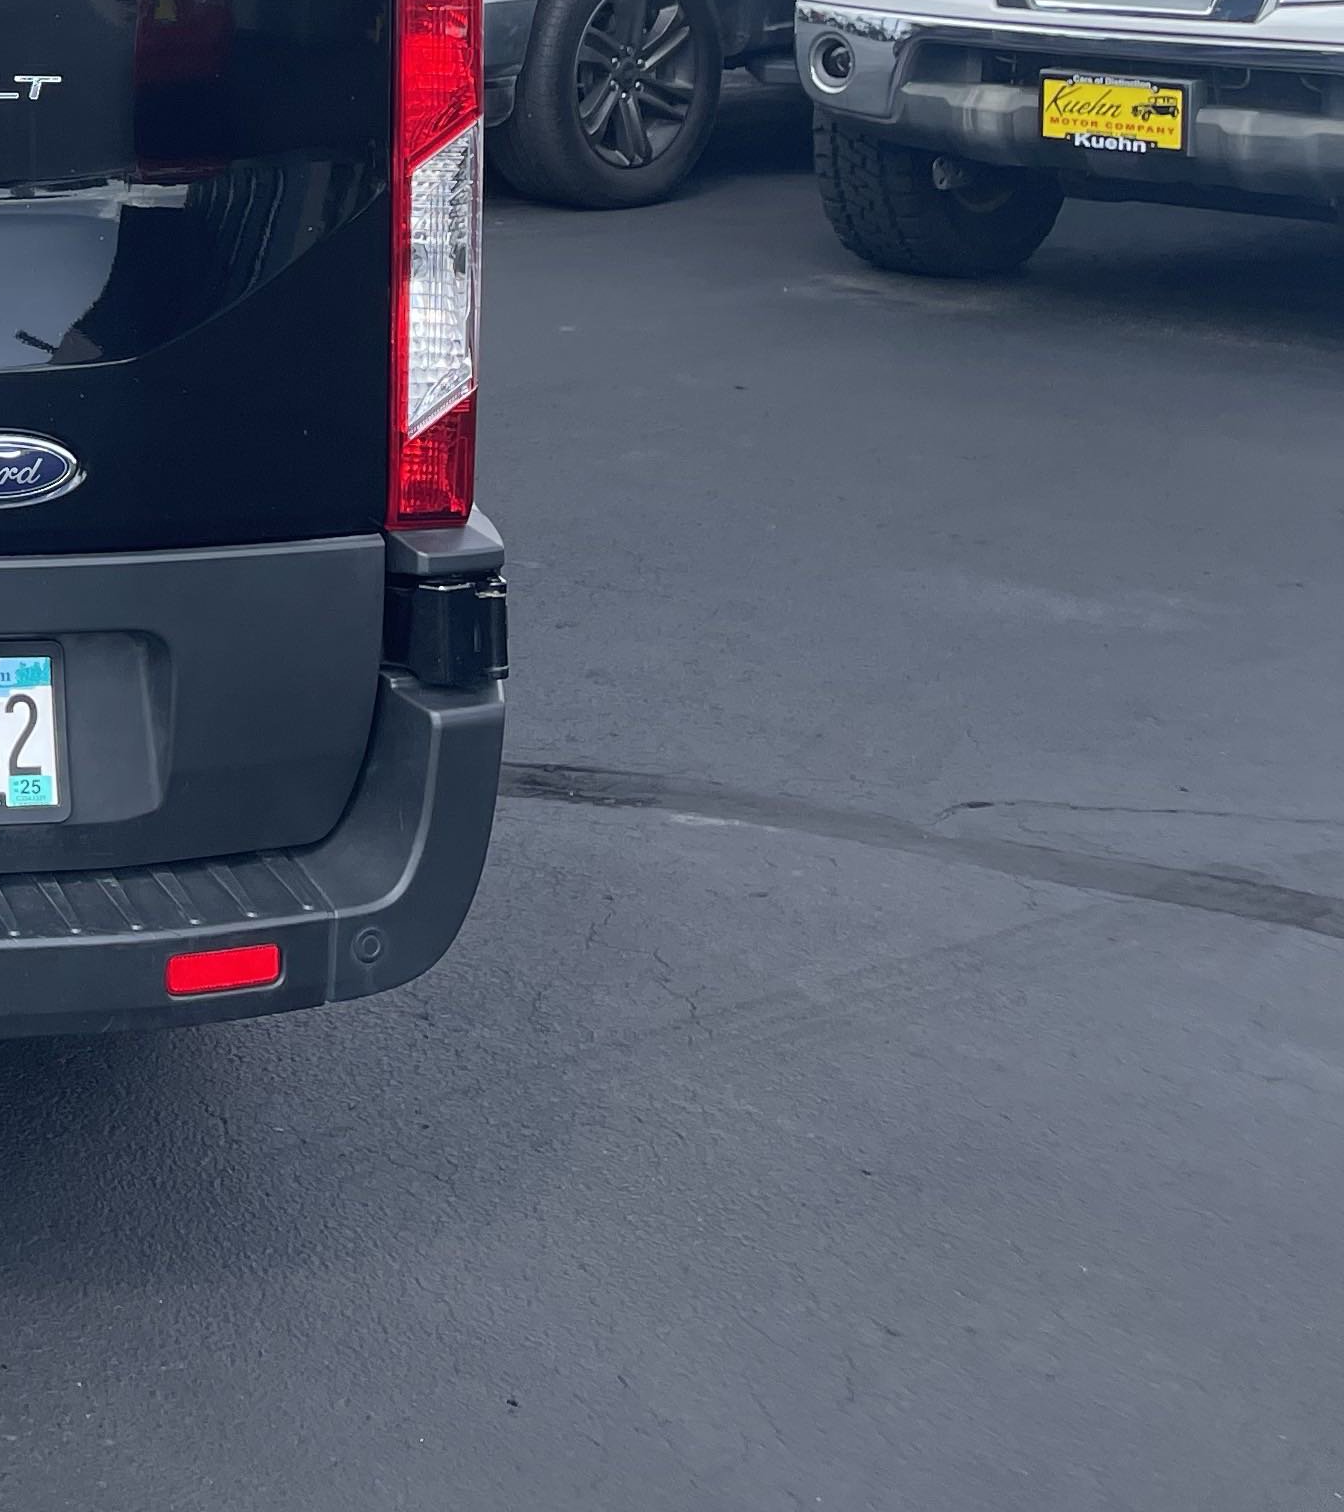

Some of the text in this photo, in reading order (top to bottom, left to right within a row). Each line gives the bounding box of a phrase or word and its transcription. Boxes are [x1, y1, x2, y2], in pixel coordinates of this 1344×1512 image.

[1045, 85, 1122, 119] Kuehn
[1050, 116, 1099, 129] MOTOR
[1105, 122, 1176, 136] COMPANY
[1074, 132, 1147, 153] Kuehn
[20, 779, 41, 795] 25
